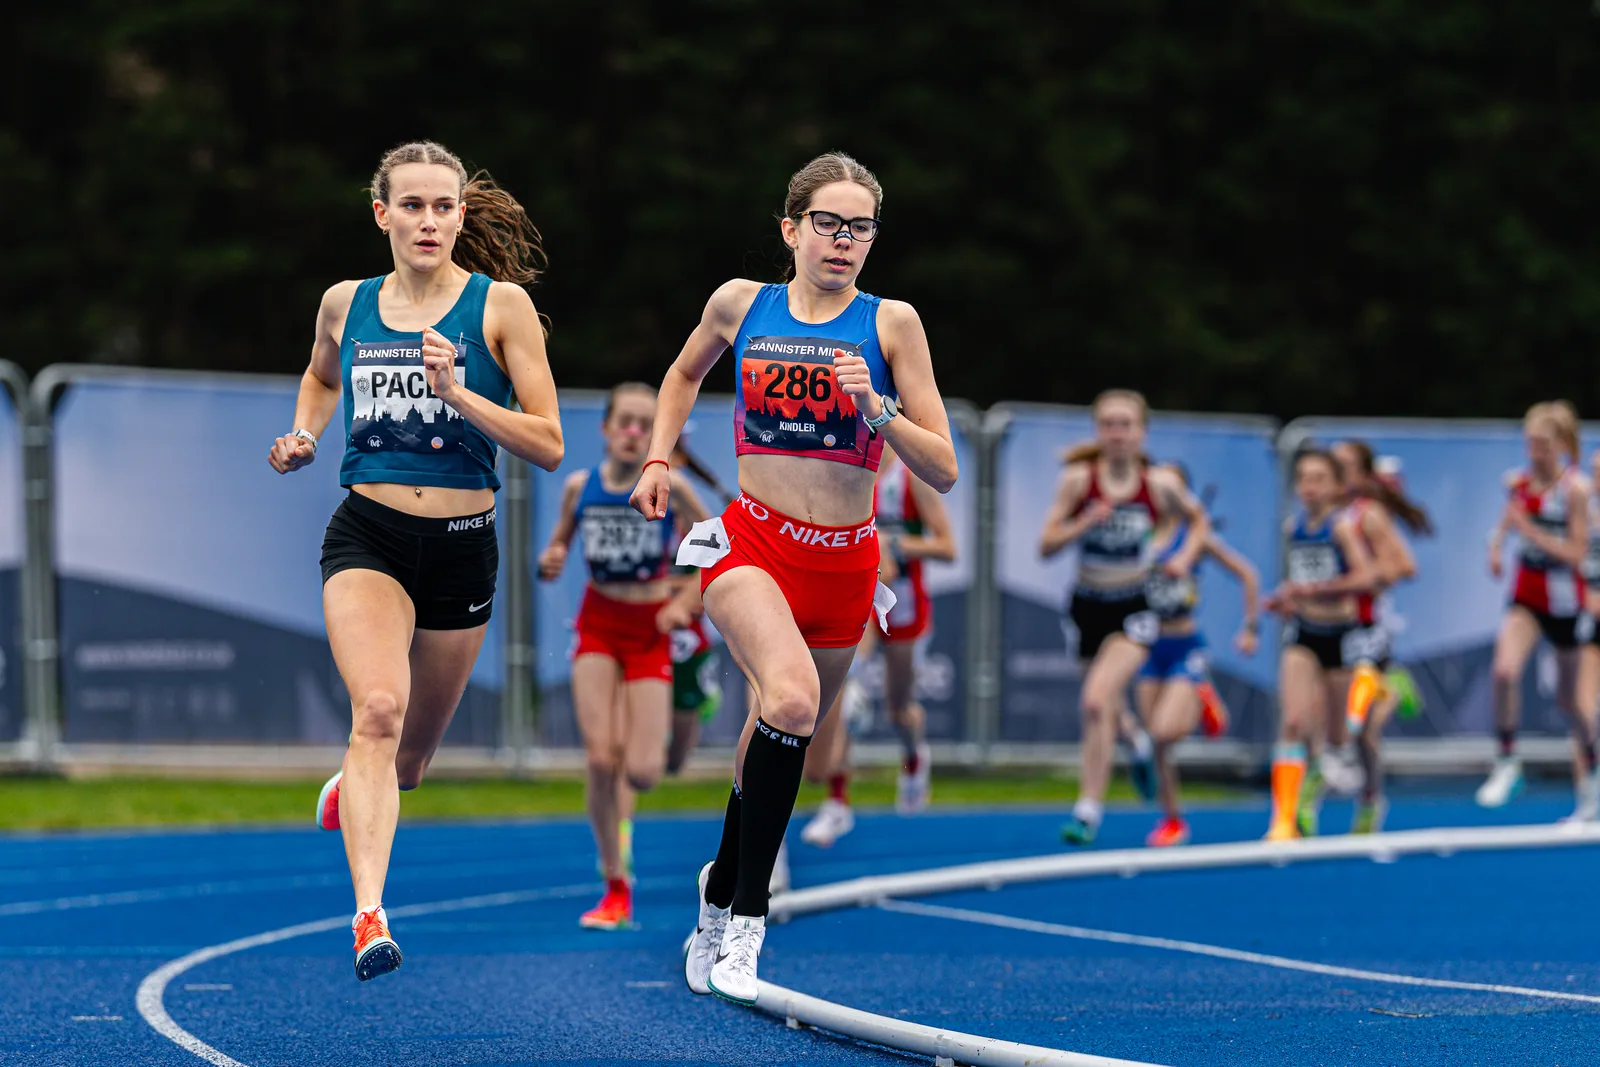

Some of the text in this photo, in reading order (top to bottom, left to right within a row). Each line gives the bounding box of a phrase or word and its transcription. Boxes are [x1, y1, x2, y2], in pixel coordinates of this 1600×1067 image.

[358, 348, 421, 359] BANNISTER
[751, 342, 854, 358] BANNISTER MILS
[764, 363, 831, 402] 286
[779, 421, 816, 432] KINDLER
[736, 489, 769, 521] RO
[447, 516, 484, 532] NIKE
[779, 521, 850, 548] NIKE
